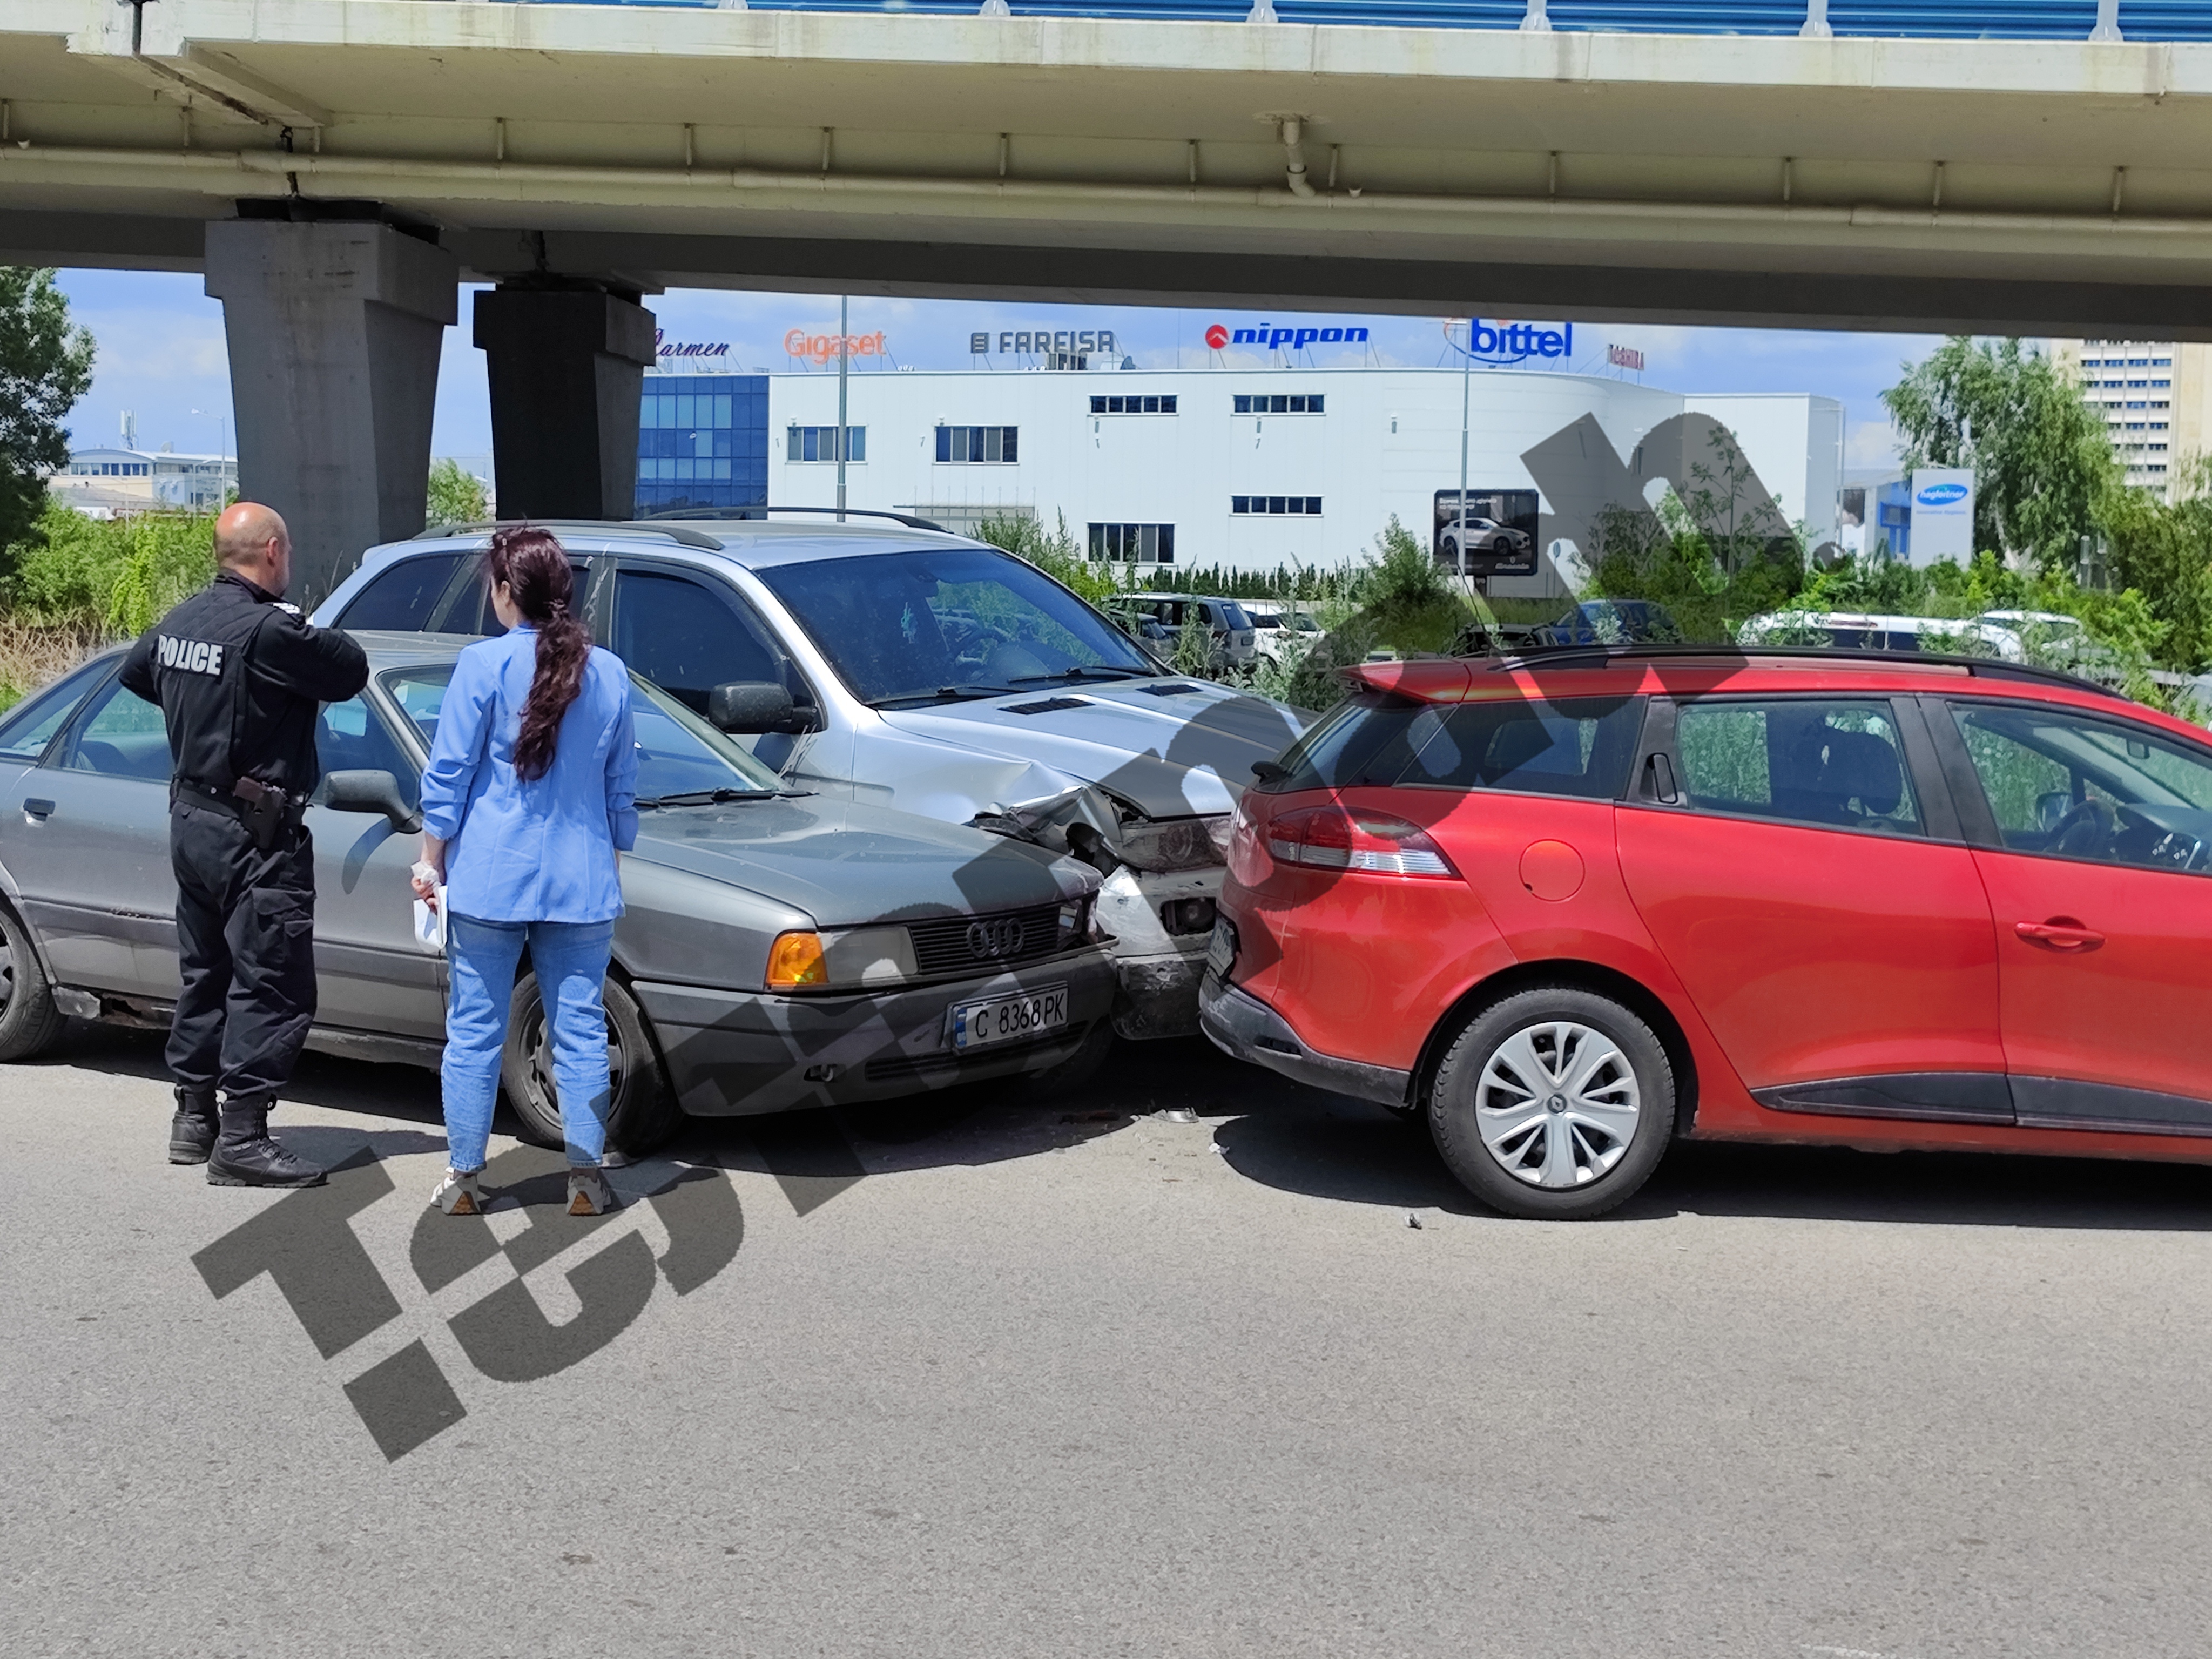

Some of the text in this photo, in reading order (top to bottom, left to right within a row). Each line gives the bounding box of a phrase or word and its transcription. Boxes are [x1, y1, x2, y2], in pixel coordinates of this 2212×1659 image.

[784, 328, 887, 365] Gigaset
[1232, 327, 1368, 349] nippon
[1471, 317, 1571, 358] bittel
[158, 634, 222, 675] POLICE
